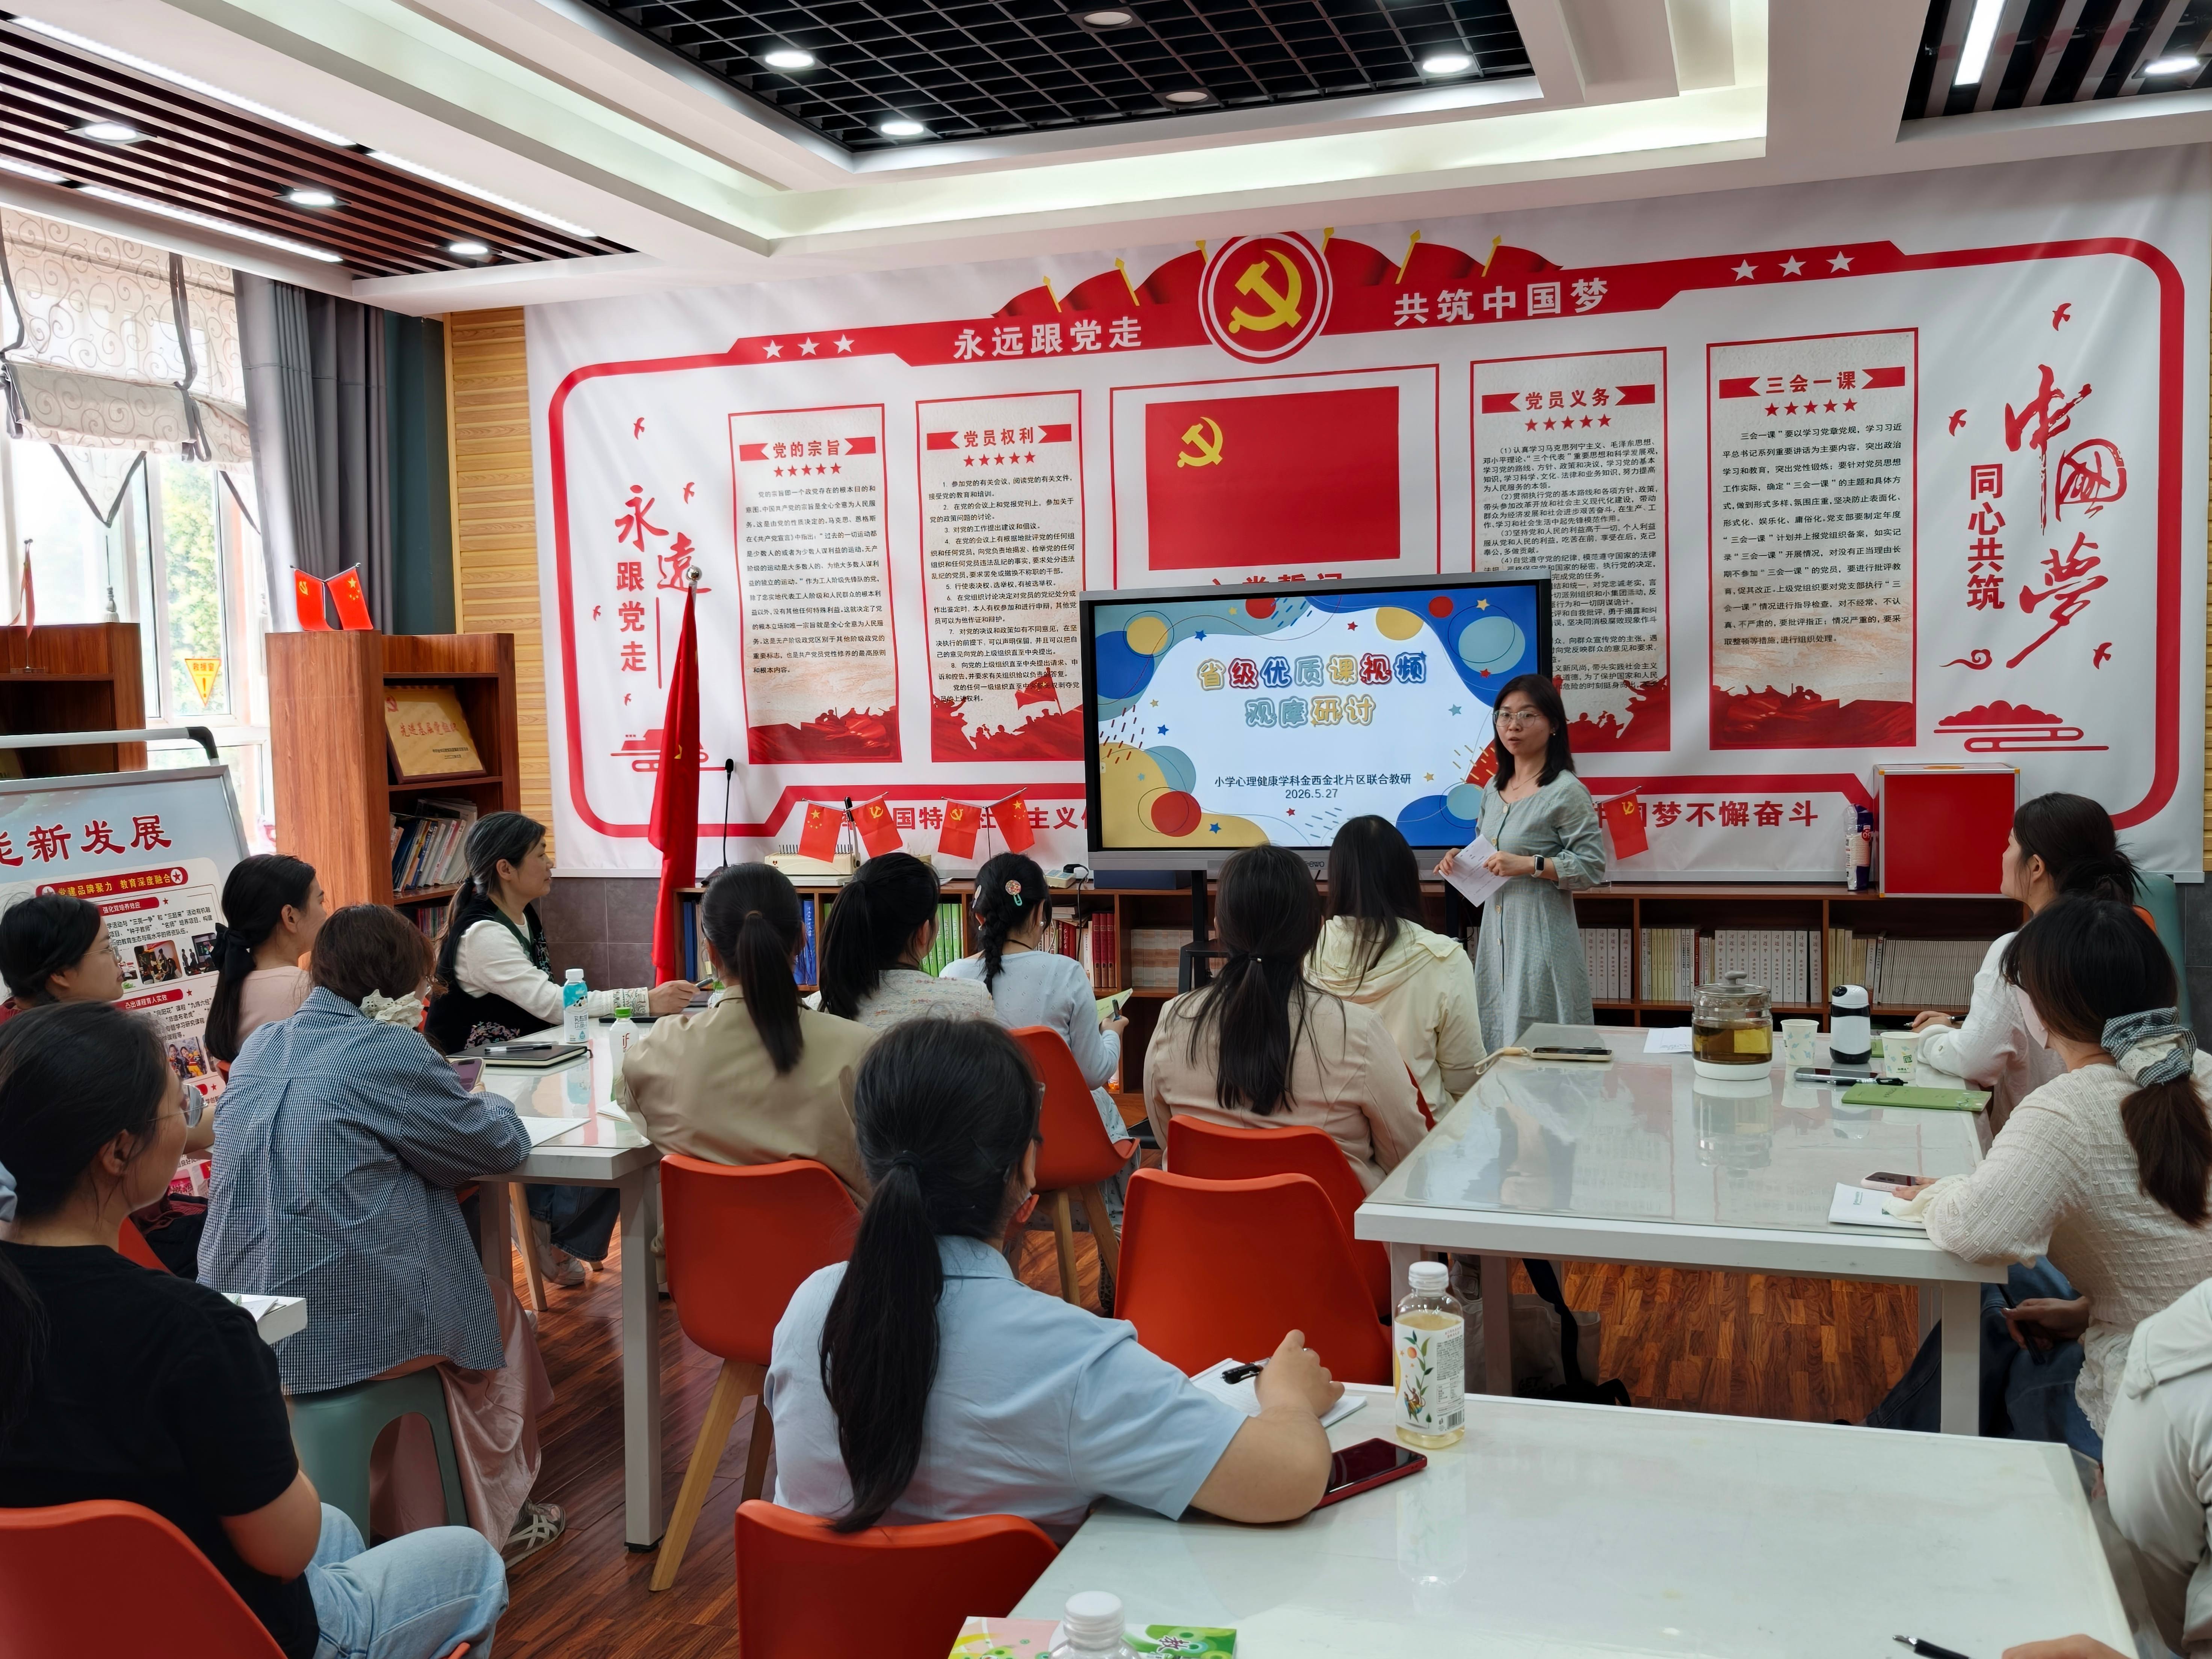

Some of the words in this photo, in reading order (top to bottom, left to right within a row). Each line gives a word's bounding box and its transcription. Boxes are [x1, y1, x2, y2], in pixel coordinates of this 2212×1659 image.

[1394, 278, 1608, 326] 共筑中国梦
[953, 316, 1141, 360] 永远跟党走
[1766, 371, 1855, 393] 三会一课
[1526, 388, 1609, 410] 党员义务
[964, 427, 1033, 447] 党员权利
[773, 440, 840, 458] 党的宗旨
[1484, 482, 1550, 492] 为人民服务的本领。
[929, 491, 994, 500] 接受党的教育和培训。
[930, 514, 994, 523] 党的政策问题的讨论。
[953, 523, 1040, 532] 对党的工作提出建议和倡议。
[956, 533, 1074, 544] 在党的会议上有根据地批评党的任何组
[1967, 464, 2005, 610] 同心共筑
[1552, 579, 1656, 589] 结和统一，对党忠诚老实，言
[957, 591, 1076, 601] 在党组织讨论决定对党员的党纪处分或
[1552, 588, 1656, 598] 切派别组织和小集团活动，反
[616, 562, 646, 671] 跟党走
[935, 616, 1005, 624] 员可以为他作证和辩护。
[937, 649, 1055, 658] 己的意见向党的上级组织直至中央提出。
[1197, 651, 1427, 690] 省级优质课视频
[1552, 663, 1657, 671] 义新风尚，带头实践社会主义
[1245, 694, 1376, 728] 观摩研讨
[1215, 773, 1411, 787] 小学心理健康学科金西金北片区联合教研
[1285, 789, 1338, 799] 2026.5.27
[1593, 800, 1818, 828] 梦不懈奋斗
[120, 874, 171, 889] 教育深度融合
[622, 1032, 630, 1049] if
